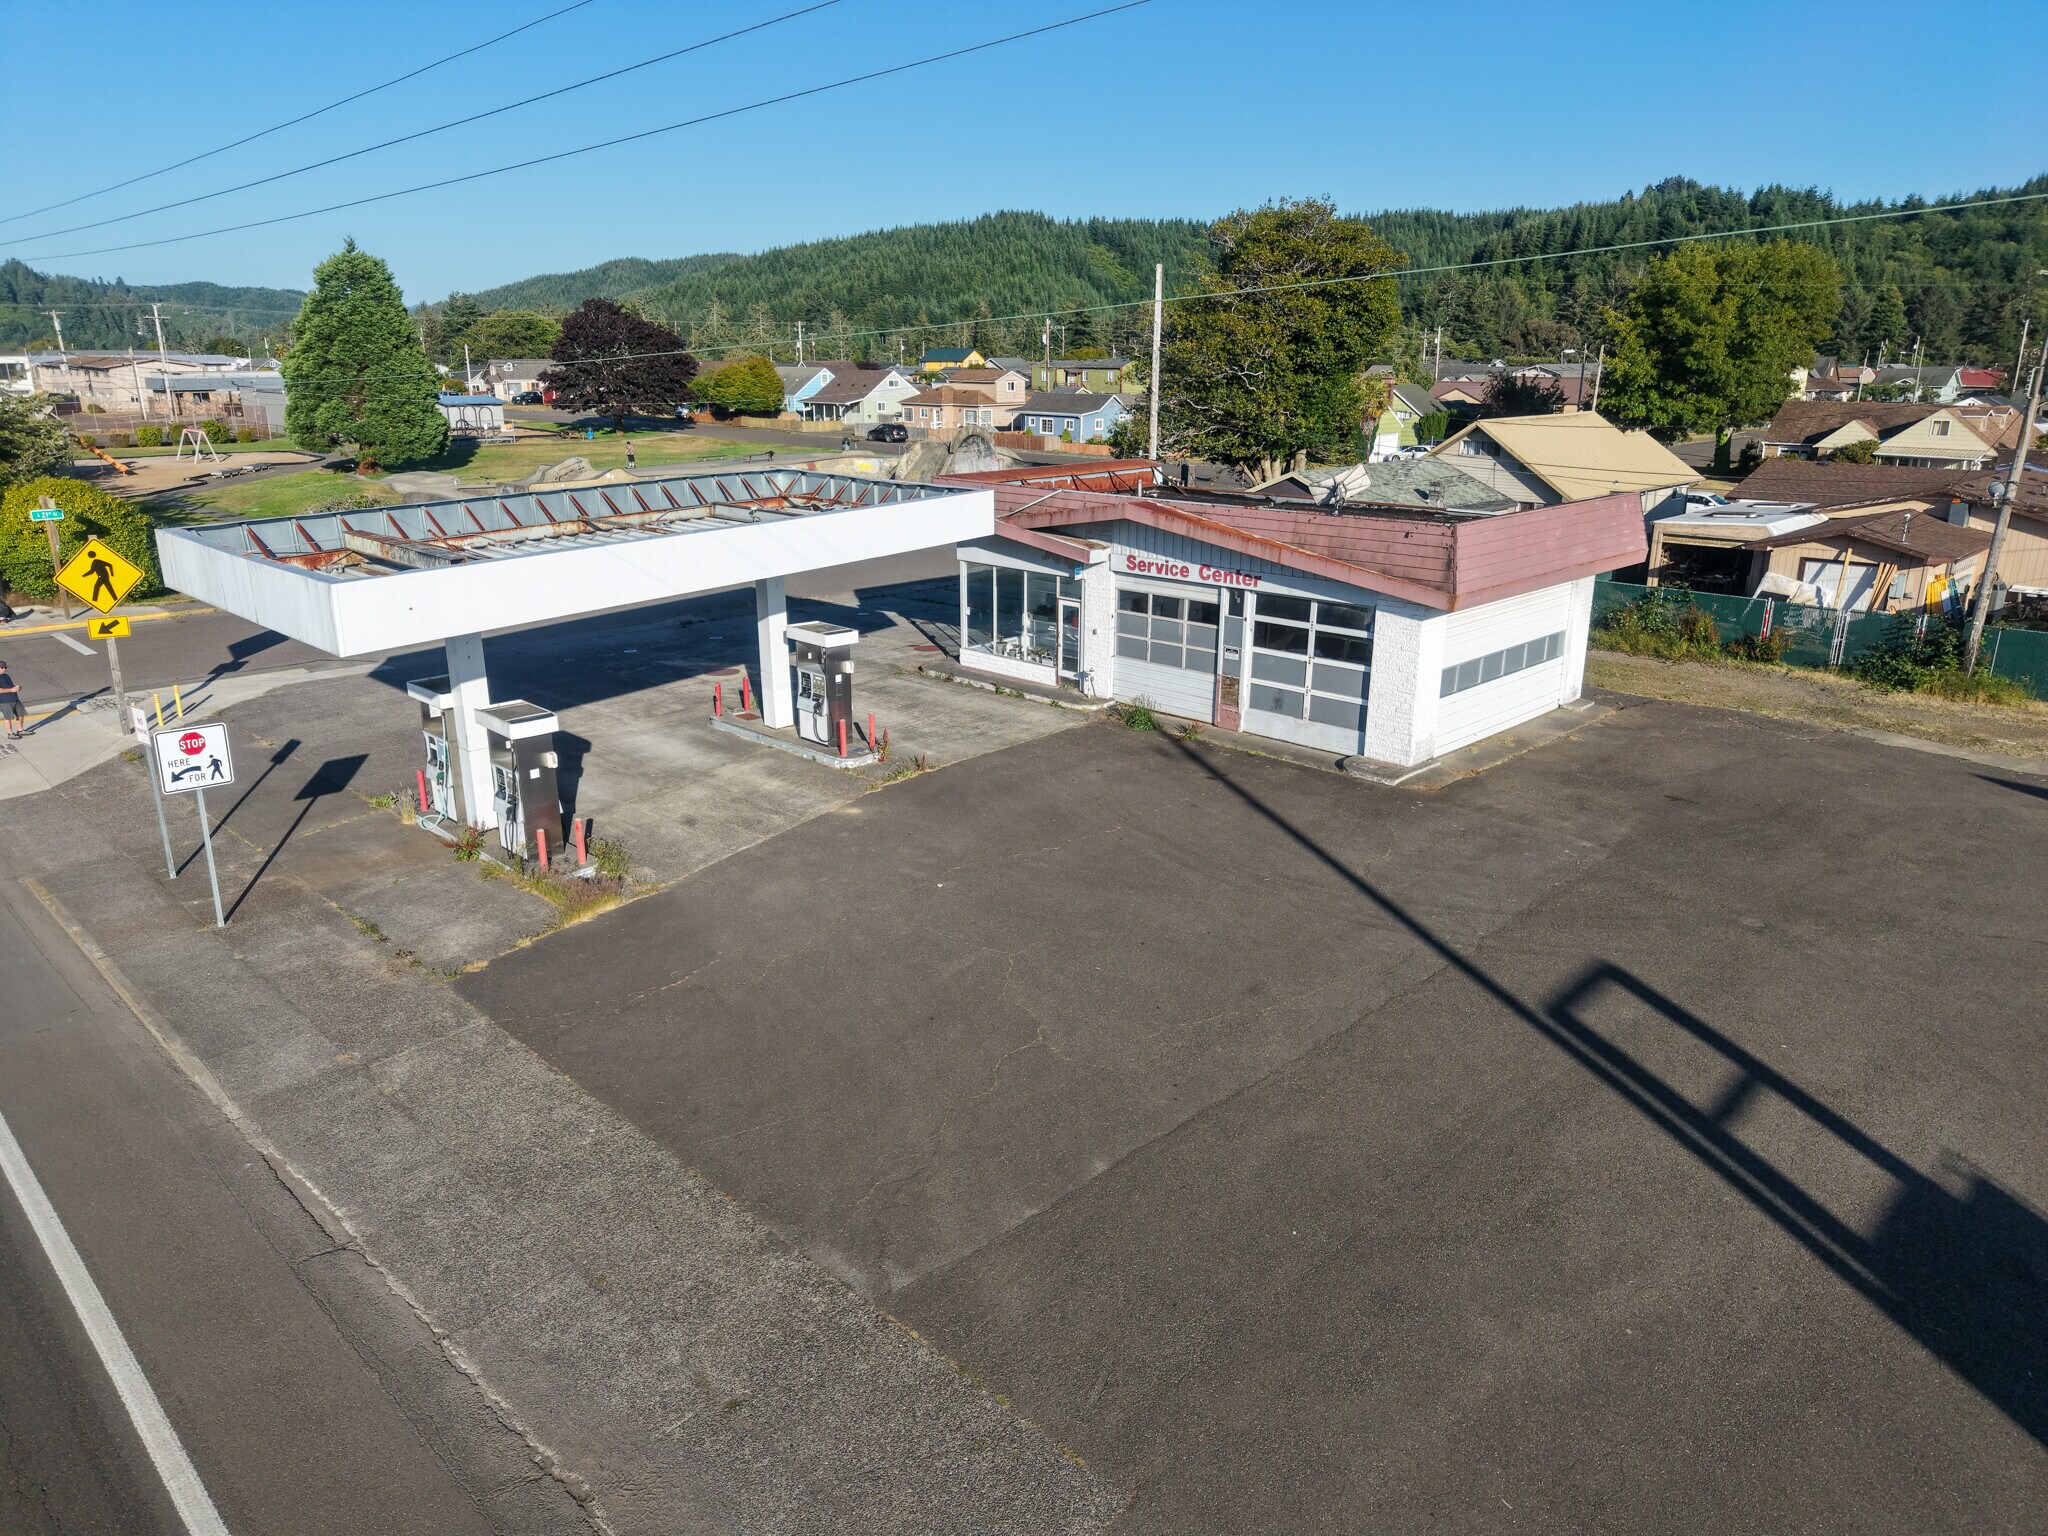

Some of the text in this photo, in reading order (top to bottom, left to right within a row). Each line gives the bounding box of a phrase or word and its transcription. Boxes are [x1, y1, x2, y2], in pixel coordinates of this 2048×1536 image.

[1126, 554, 1262, 588] Service Center
[180, 737, 205, 750] STOP
[168, 758, 191, 768] HERE
[189, 773, 206, 782] FOR
